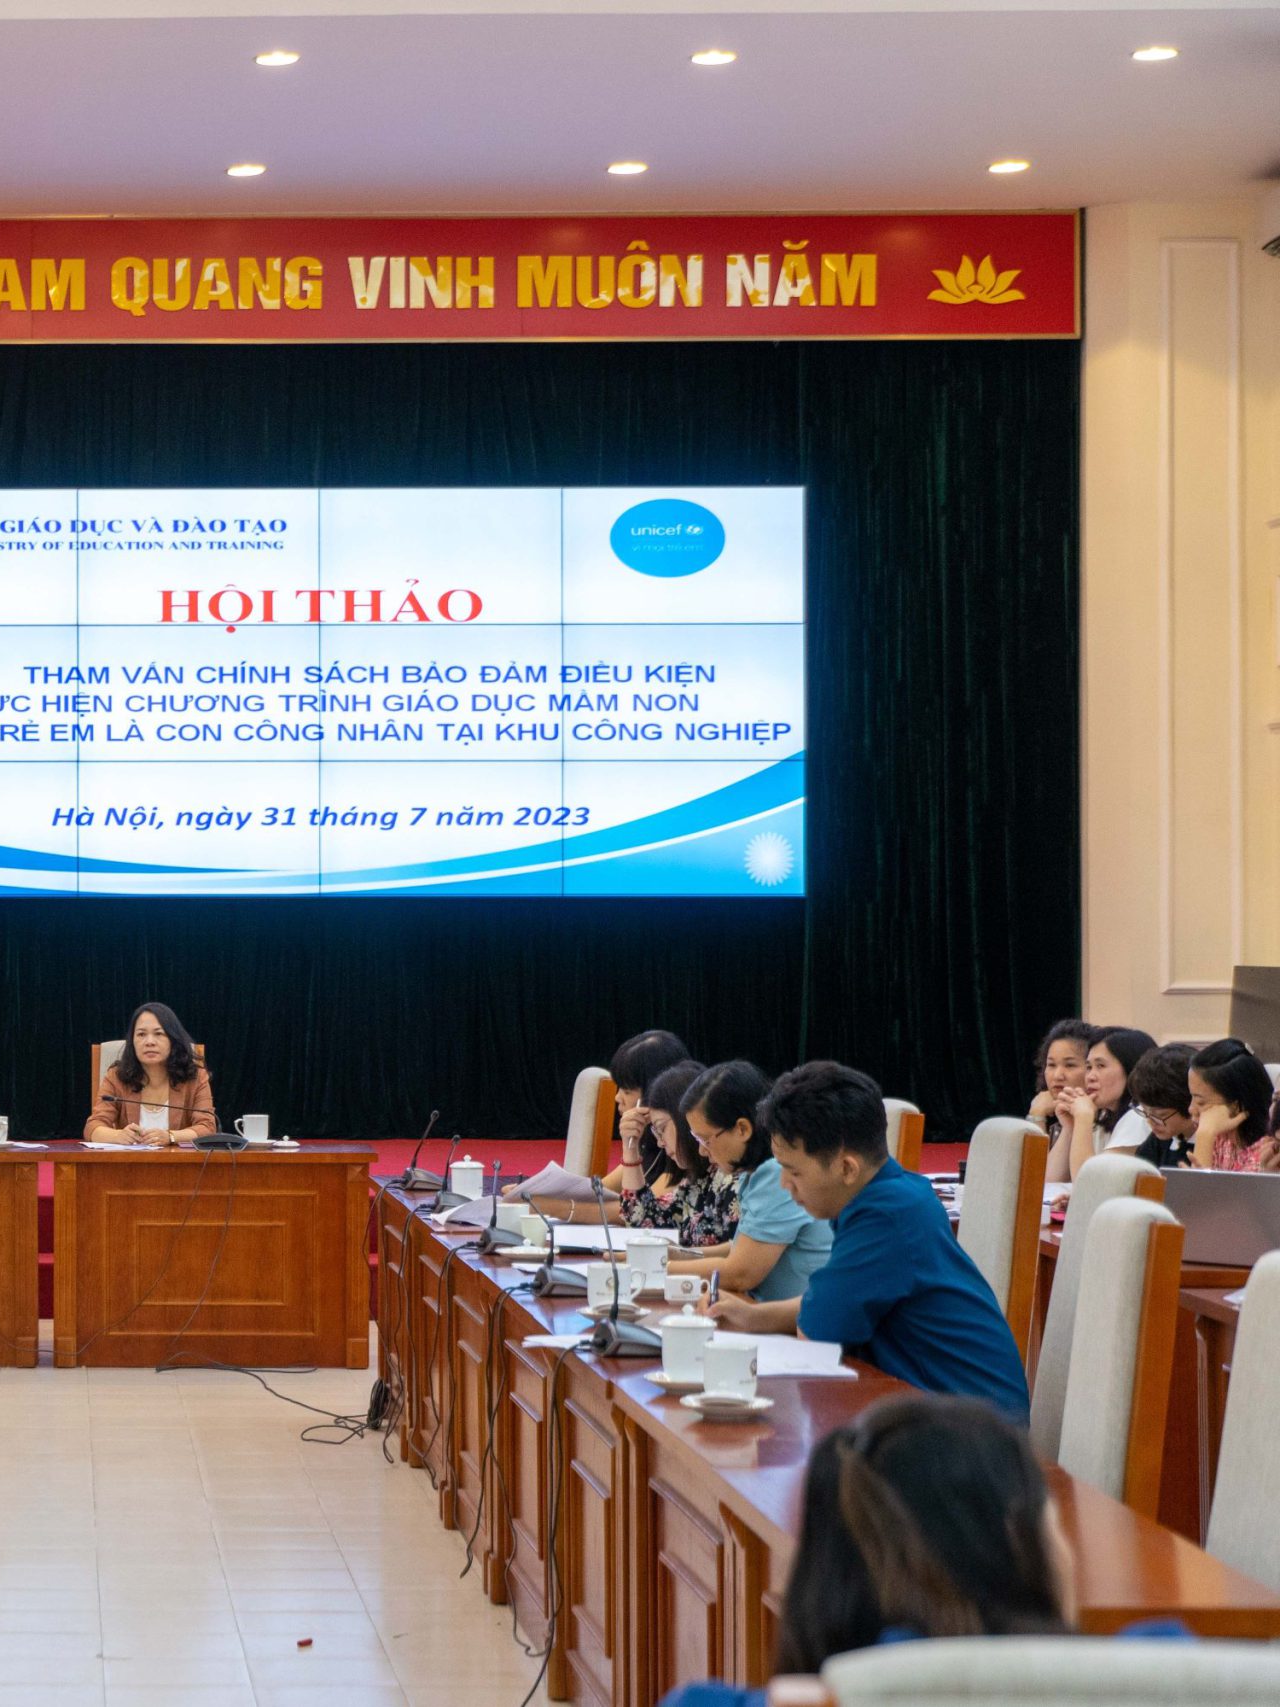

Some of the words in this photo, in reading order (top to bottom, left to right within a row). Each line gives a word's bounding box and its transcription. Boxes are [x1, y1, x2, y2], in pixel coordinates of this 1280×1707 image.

[110, 257, 324, 316] QUANG
[348, 256, 495, 309] VINH
[517, 241, 704, 309] MUÔN
[726, 240, 877, 308] NĂM
[0, 515, 62, 534] GIÁO
[70, 519, 123, 537] DỤC
[131, 515, 166, 533] VÀ
[172, 515, 227, 534] ĐÀO
[233, 519, 288, 537] TẠO
[631, 524, 682, 536] unicef
[41, 540, 65, 551] OF
[68, 540, 163, 551] EDUCATION
[168, 540, 202, 551] AND
[206, 539, 284, 550] TRAINING
[157, 584, 279, 633] HỘI
[294, 579, 483, 623] THẢO
[24, 665, 110, 685] THAM
[121, 660, 184, 685] VẤN
[195, 661, 291, 684] CHÍNH
[303, 661, 390, 684] SÁCH
[401, 661, 468, 684] BẢO
[479, 661, 548, 684] ĐẢM
[559, 660, 633, 684] ĐIỀU
[644, 661, 716, 687] KIỆN
[41, 692, 113, 718] HIỆN
[124, 694, 265, 713] CHƯƠNG
[279, 689, 372, 713] TRÌNH
[382, 689, 460, 712] GIÁO
[470, 694, 536, 717] DỤC
[632, 694, 700, 712] NON
[50, 723, 95, 743] EM
[106, 719, 145, 742] LÀ
[156, 723, 222, 742] CON
[233, 719, 325, 742] CÔNG
[337, 719, 424, 742] NHÂN
[436, 723, 484, 746] TẠI
[495, 723, 560, 742] KHU
[571, 718, 663, 742] CÔNG
[675, 719, 792, 746] NGHIỆP
[51, 806, 95, 828] Hà
[104, 805, 164, 832] Nội,
[175, 806, 253, 832] ngày
[262, 806, 296, 827] 31
[309, 805, 398, 832] tháng
[410, 807, 428, 827] 7
[435, 806, 504, 827] năm
[513, 806, 591, 827] 2023
